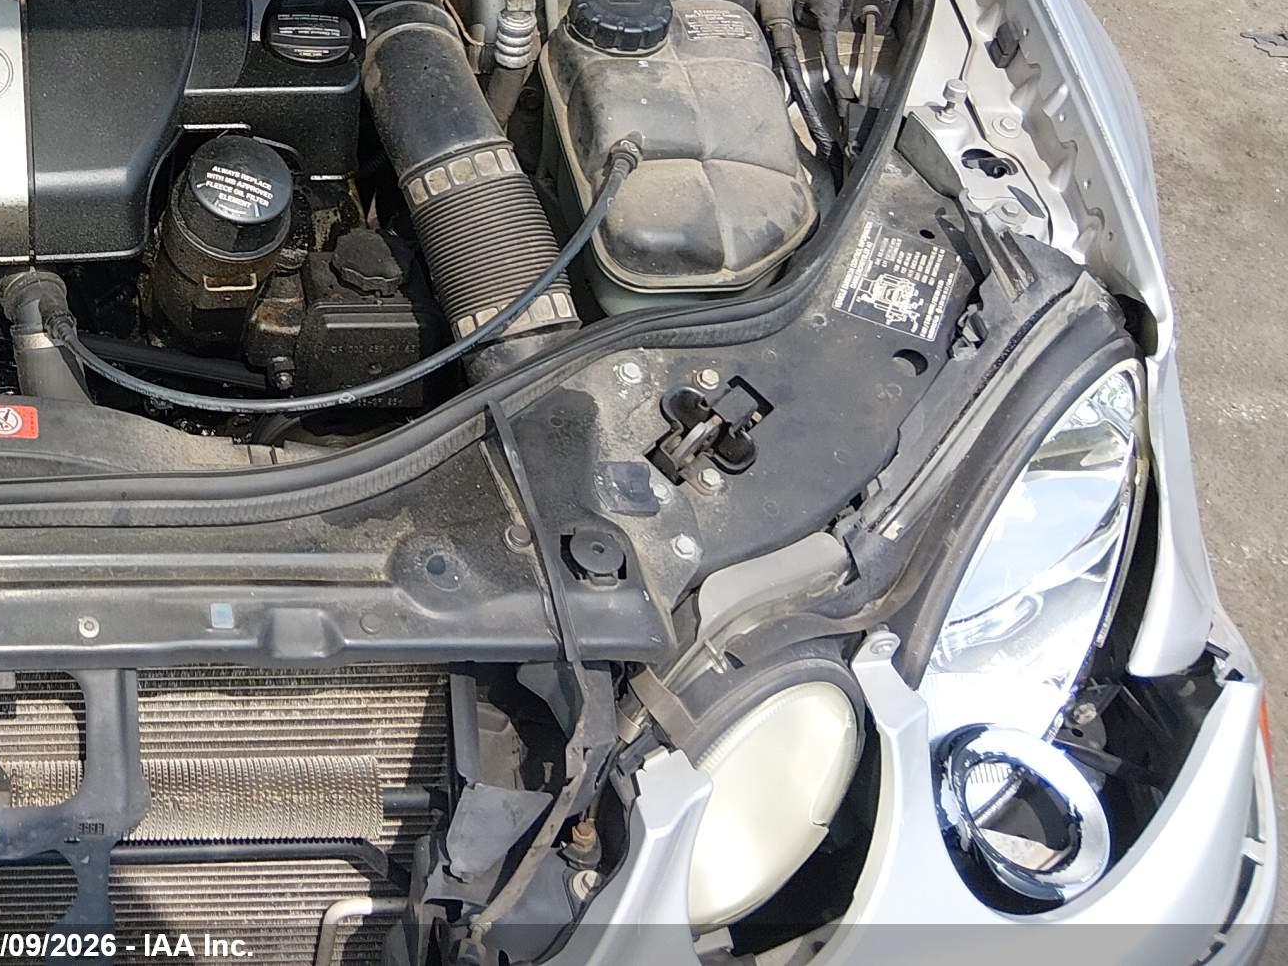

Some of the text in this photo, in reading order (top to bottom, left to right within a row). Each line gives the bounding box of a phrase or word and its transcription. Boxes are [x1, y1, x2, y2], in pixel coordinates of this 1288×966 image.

[206, 172, 224, 182] WITH
[237, 180, 273, 200] APPROVED
[212, 166, 273, 190] ALWAYS REPLACE
[206, 180, 270, 207] FLEECE OIL FILTER
[219, 192, 252, 208] ELEMENT
